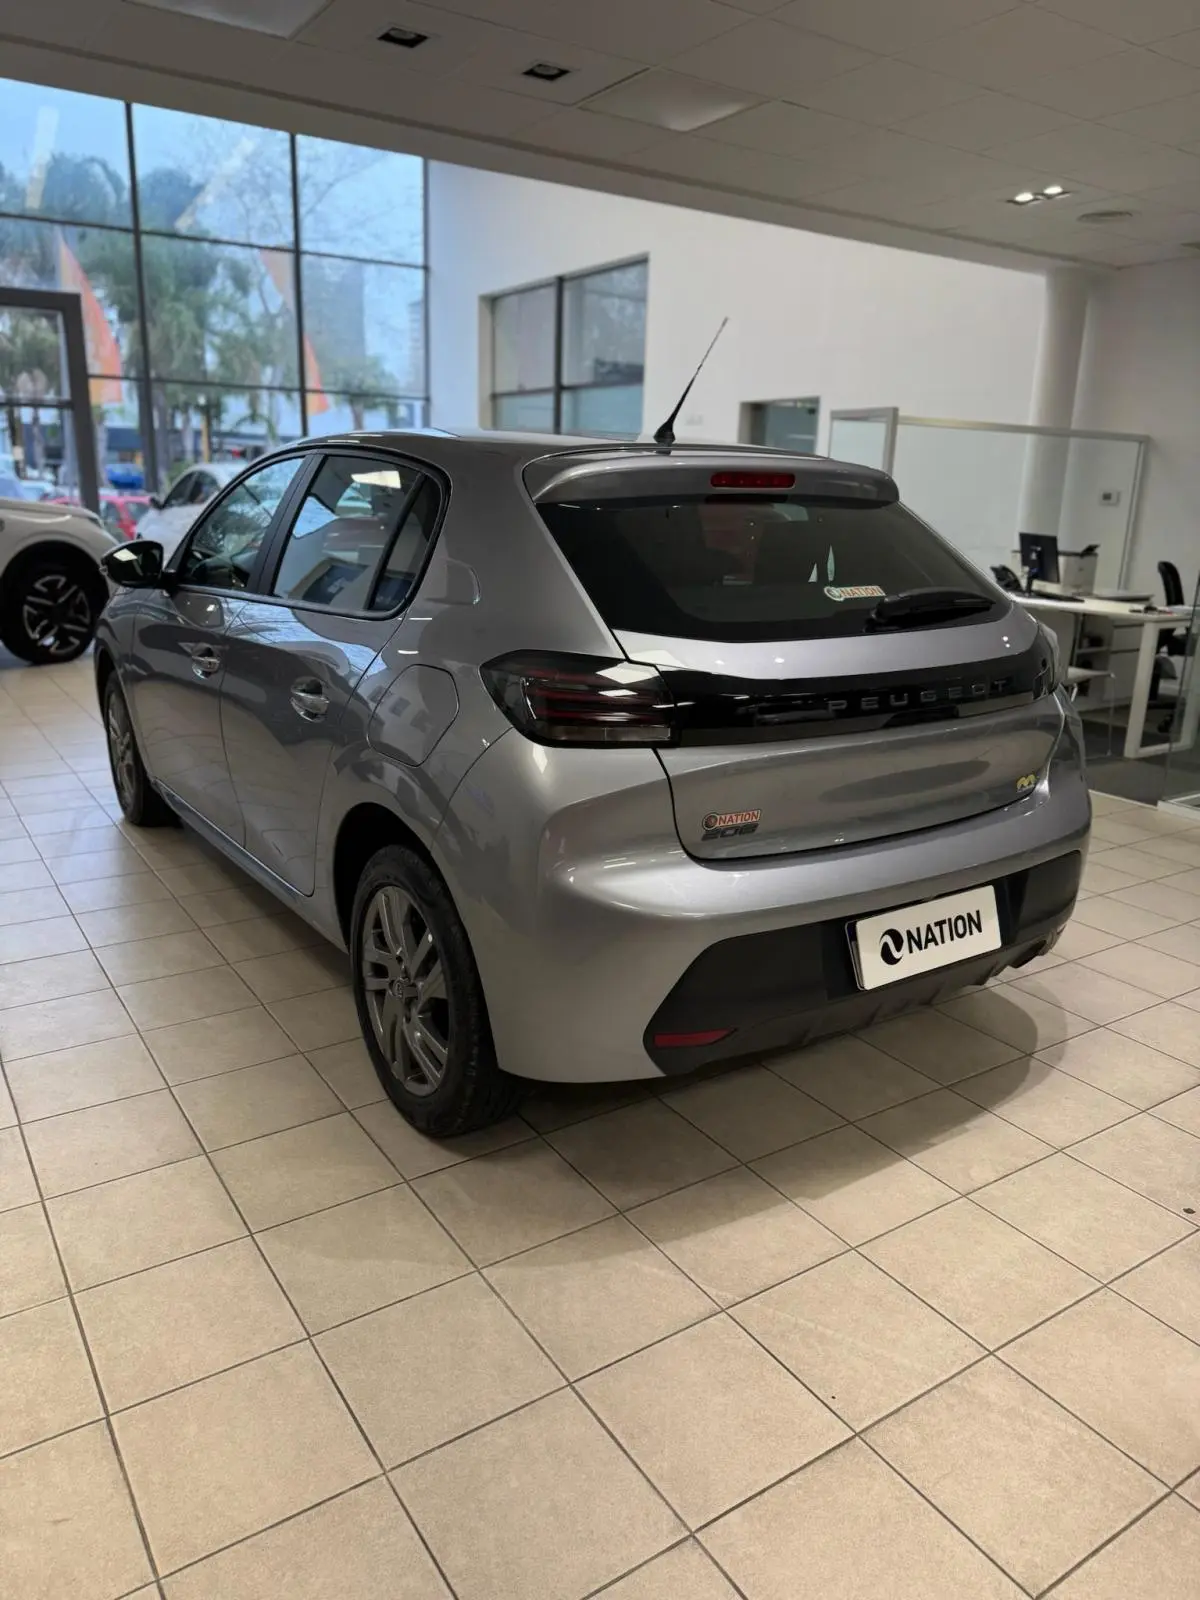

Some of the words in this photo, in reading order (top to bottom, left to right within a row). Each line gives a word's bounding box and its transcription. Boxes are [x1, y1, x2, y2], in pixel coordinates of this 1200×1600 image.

[840, 587, 884, 597] NATION
[827, 679, 1007, 712] PEUGEOT
[718, 811, 760, 825] NATION
[906, 909, 983, 954] NATION
